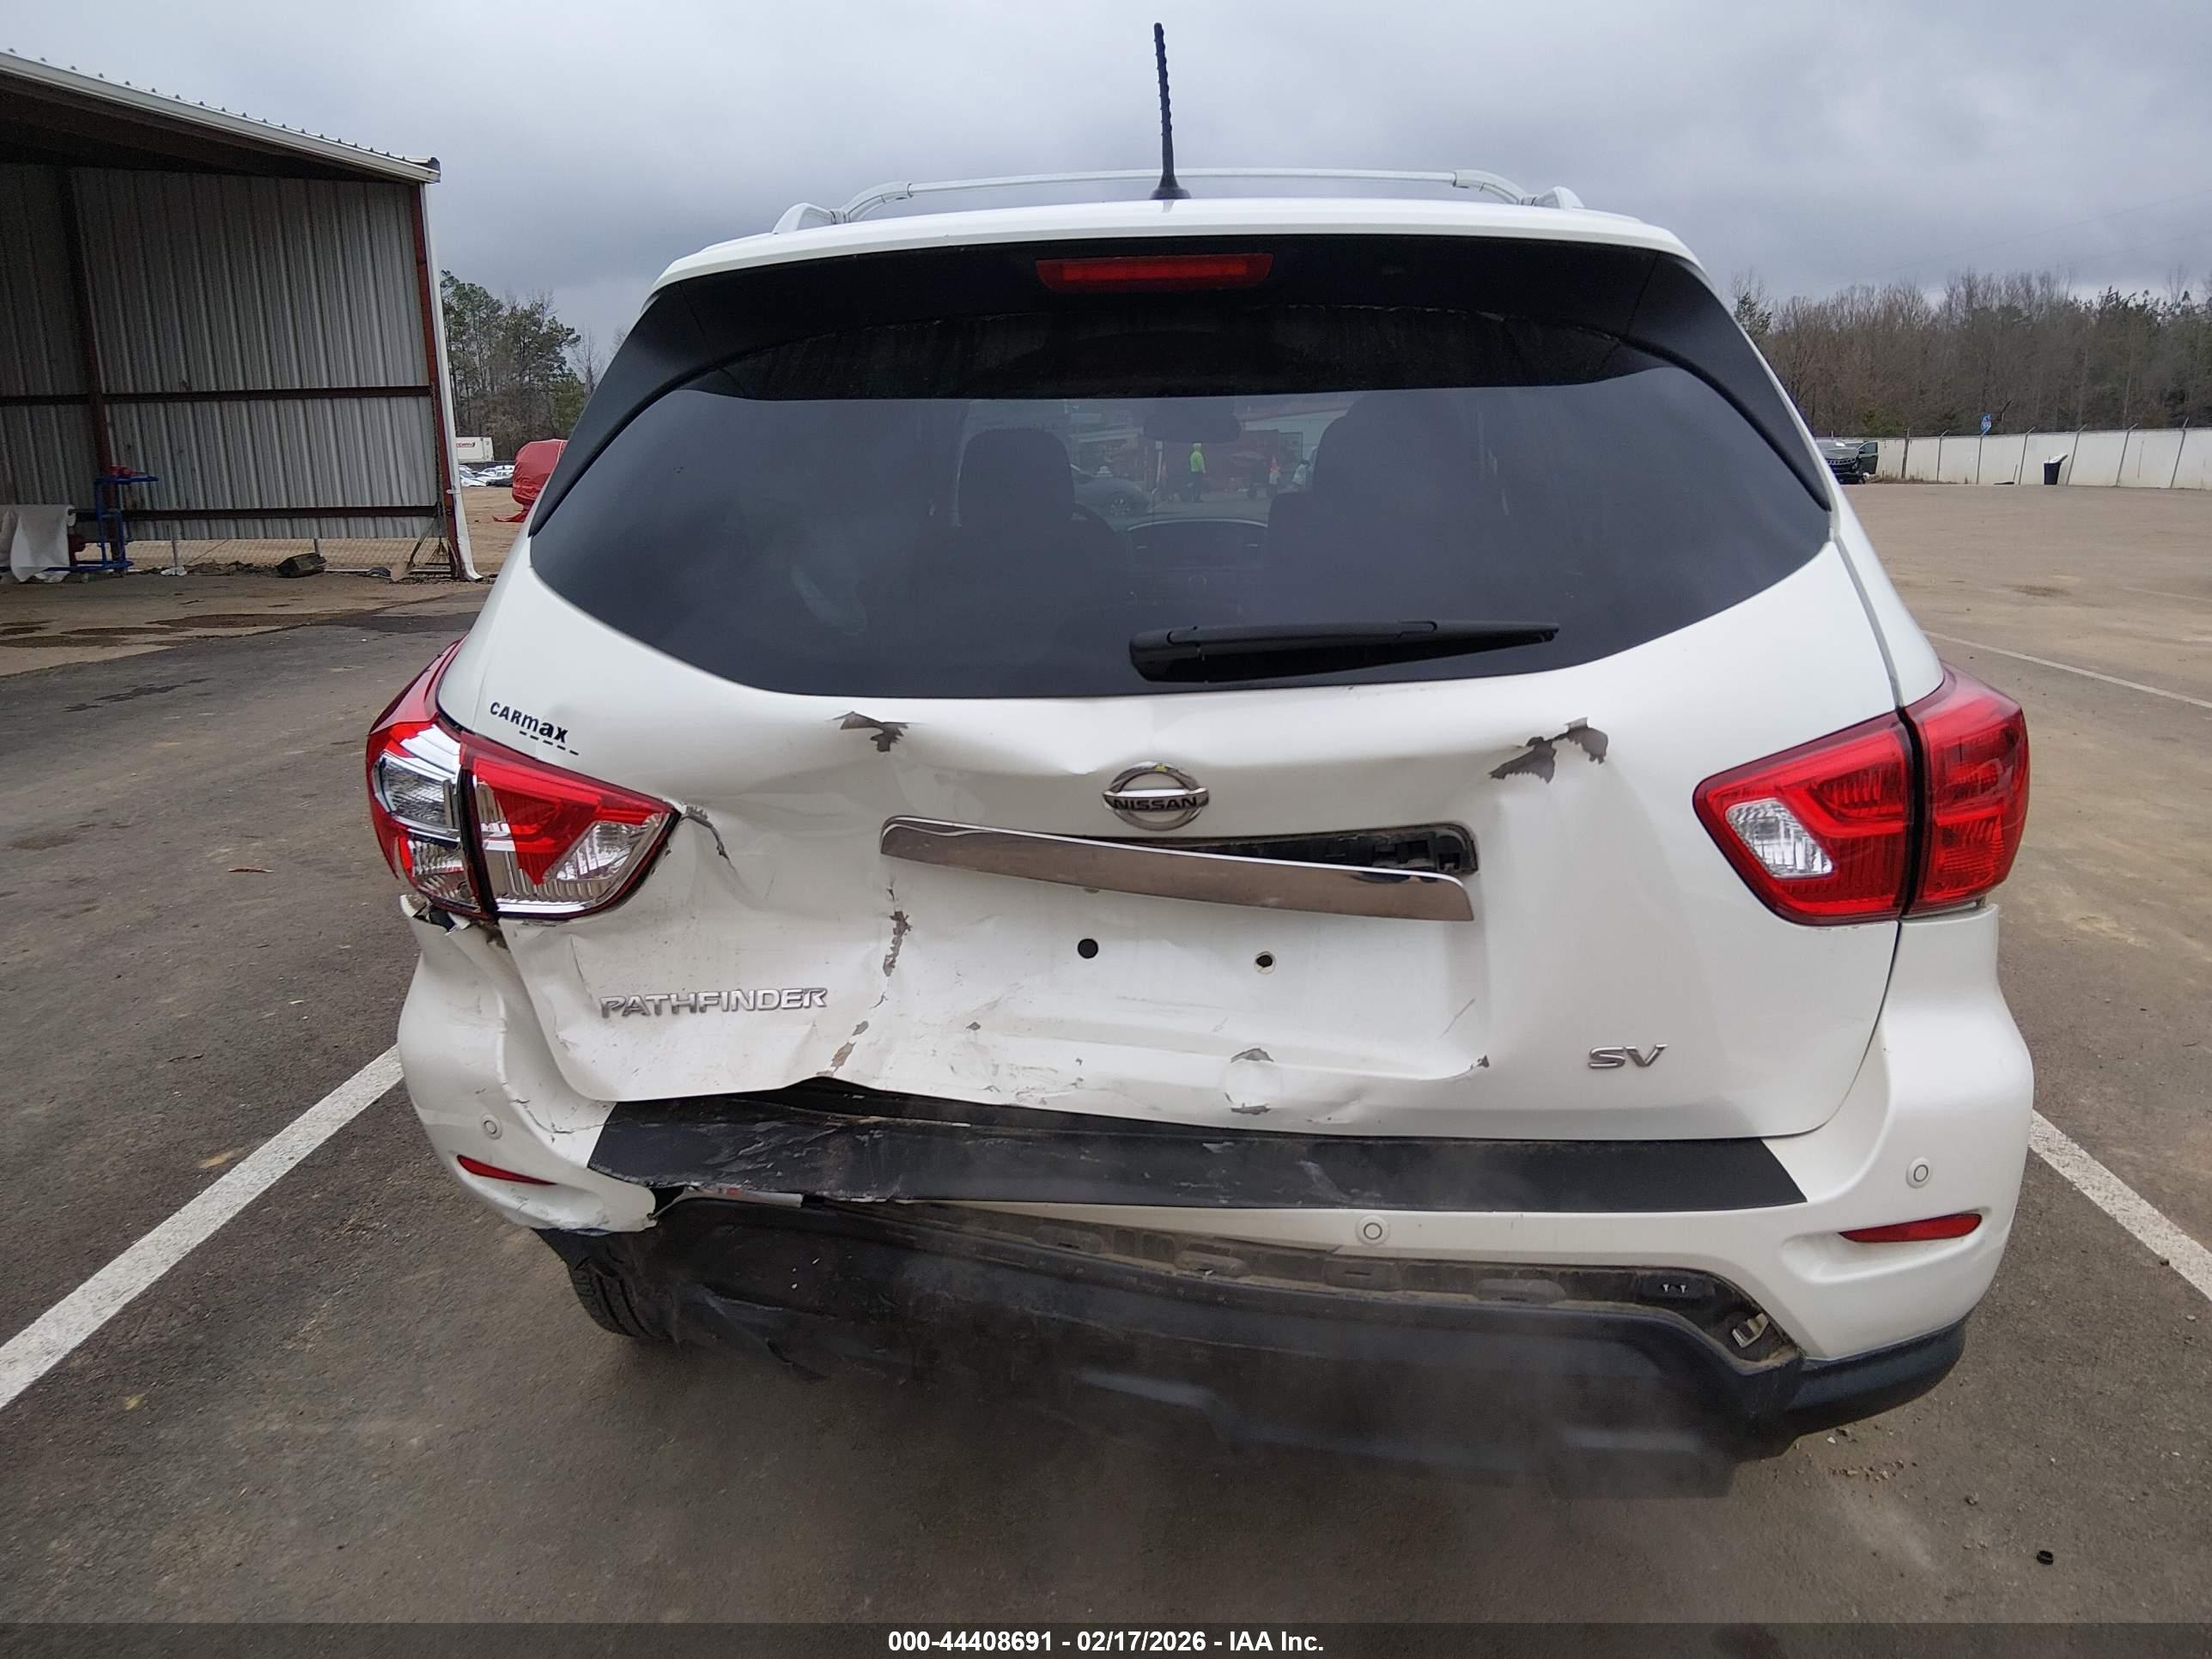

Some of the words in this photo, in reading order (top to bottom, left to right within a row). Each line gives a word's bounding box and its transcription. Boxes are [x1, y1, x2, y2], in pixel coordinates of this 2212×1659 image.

[1113, 796, 1197, 811] NISSAN
[600, 988, 827, 1018] PATHFINDER
[1589, 1043, 1668, 1069] SV
